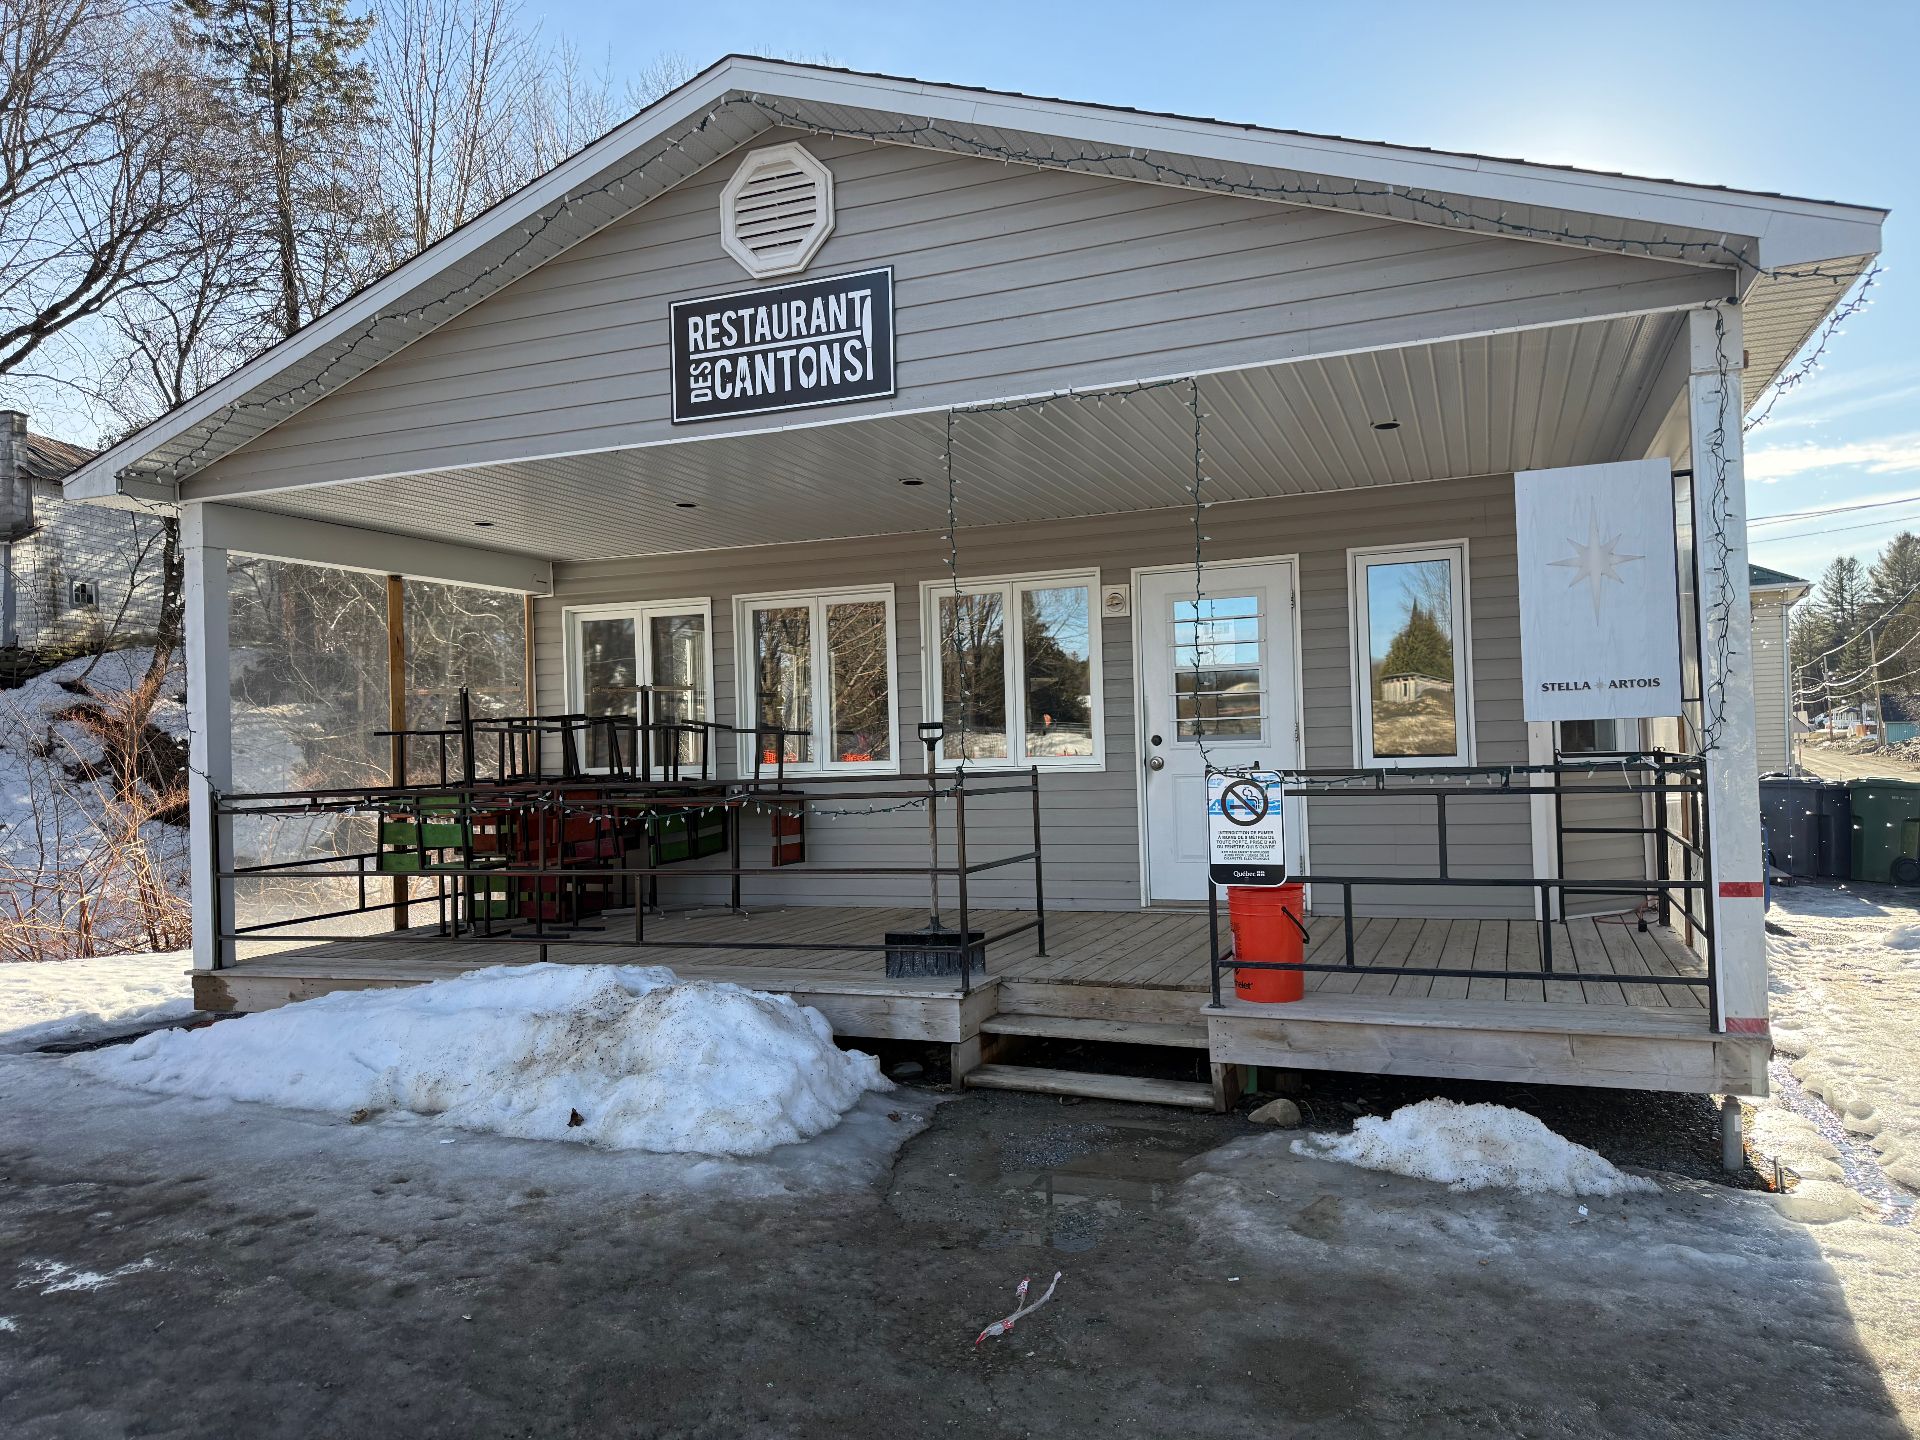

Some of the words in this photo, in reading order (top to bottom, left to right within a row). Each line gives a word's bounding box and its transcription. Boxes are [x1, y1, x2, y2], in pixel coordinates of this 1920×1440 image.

[688, 289, 872, 352] RESTAURANT
[690, 361, 713, 404] DES
[714, 339, 864, 400] CANTONS
[1541, 681, 1592, 693] STELLA
[1608, 677, 1661, 690] ARTOIS
